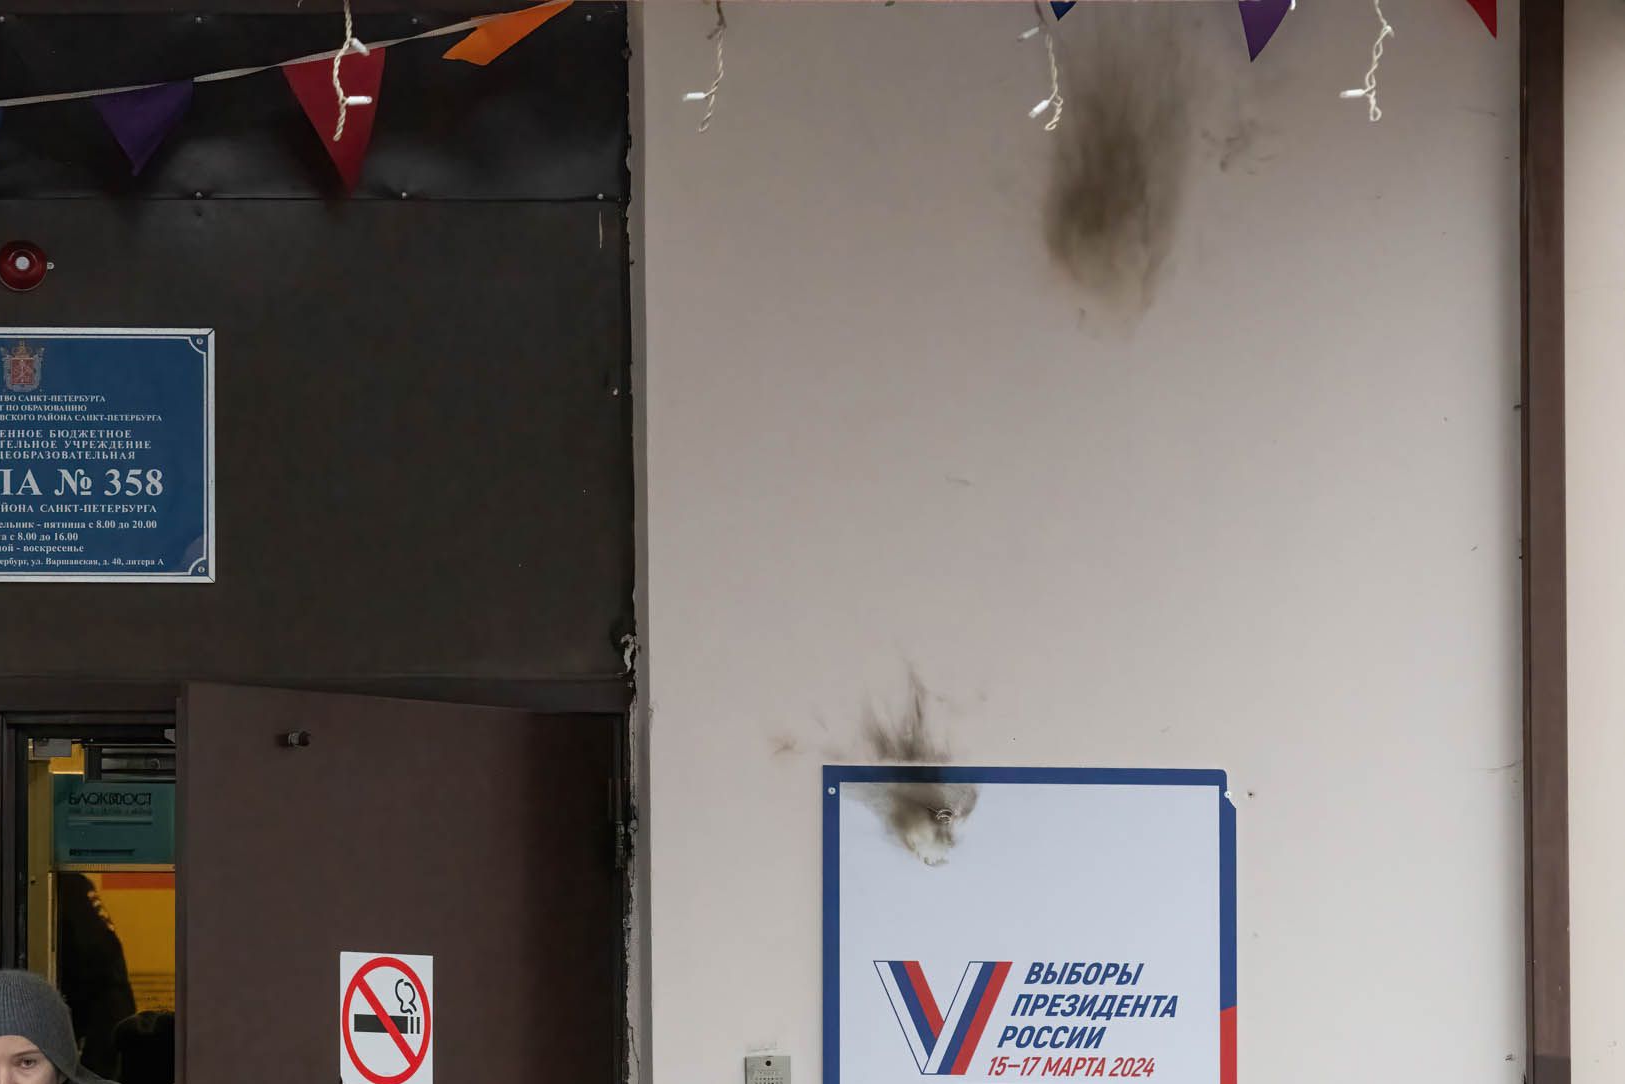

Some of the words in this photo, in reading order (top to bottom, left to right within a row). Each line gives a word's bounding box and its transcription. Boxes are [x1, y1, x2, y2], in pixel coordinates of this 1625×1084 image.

[6, 404, 19, 412] ПО
[20, 404, 87, 412] ОБРАЗОВАНИЮ
[37, 413, 72, 422] РАЙОНА
[74, 414, 162, 422] САНКТ-ПЕТЕРБУРГА
[49, 429, 132, 439] БЮДЖЕТНОЕ
[64, 440, 152, 450] УЧРЕЖДЕНИЕ
[53, 468, 93, 497] №
[103, 468, 164, 497] 358
[40, 504, 157, 513] САНКТ-ПЕТЕРБУРГА
[44, 521, 86, 529] пятница
[96, 520, 116, 529] 8.00
[132, 520, 157, 529] 20.00
[17, 532, 37, 541] 8.00
[39, 534, 51, 542] до
[54, 532, 79, 541] 16.00
[23, 545, 84, 554] воскресенье
[45, 557, 101, 567] Варшавская,
[126, 559, 155, 567] литера
[1023, 961, 1145, 986] ВЫБОРЫ
[1010, 994, 1179, 1021] ПРЕЗИДЕНТА
[997, 1025, 1107, 1050] РОССИИ
[1042, 1056, 1107, 1078] МАРТА
[1108, 1056, 1155, 1078] 2024
